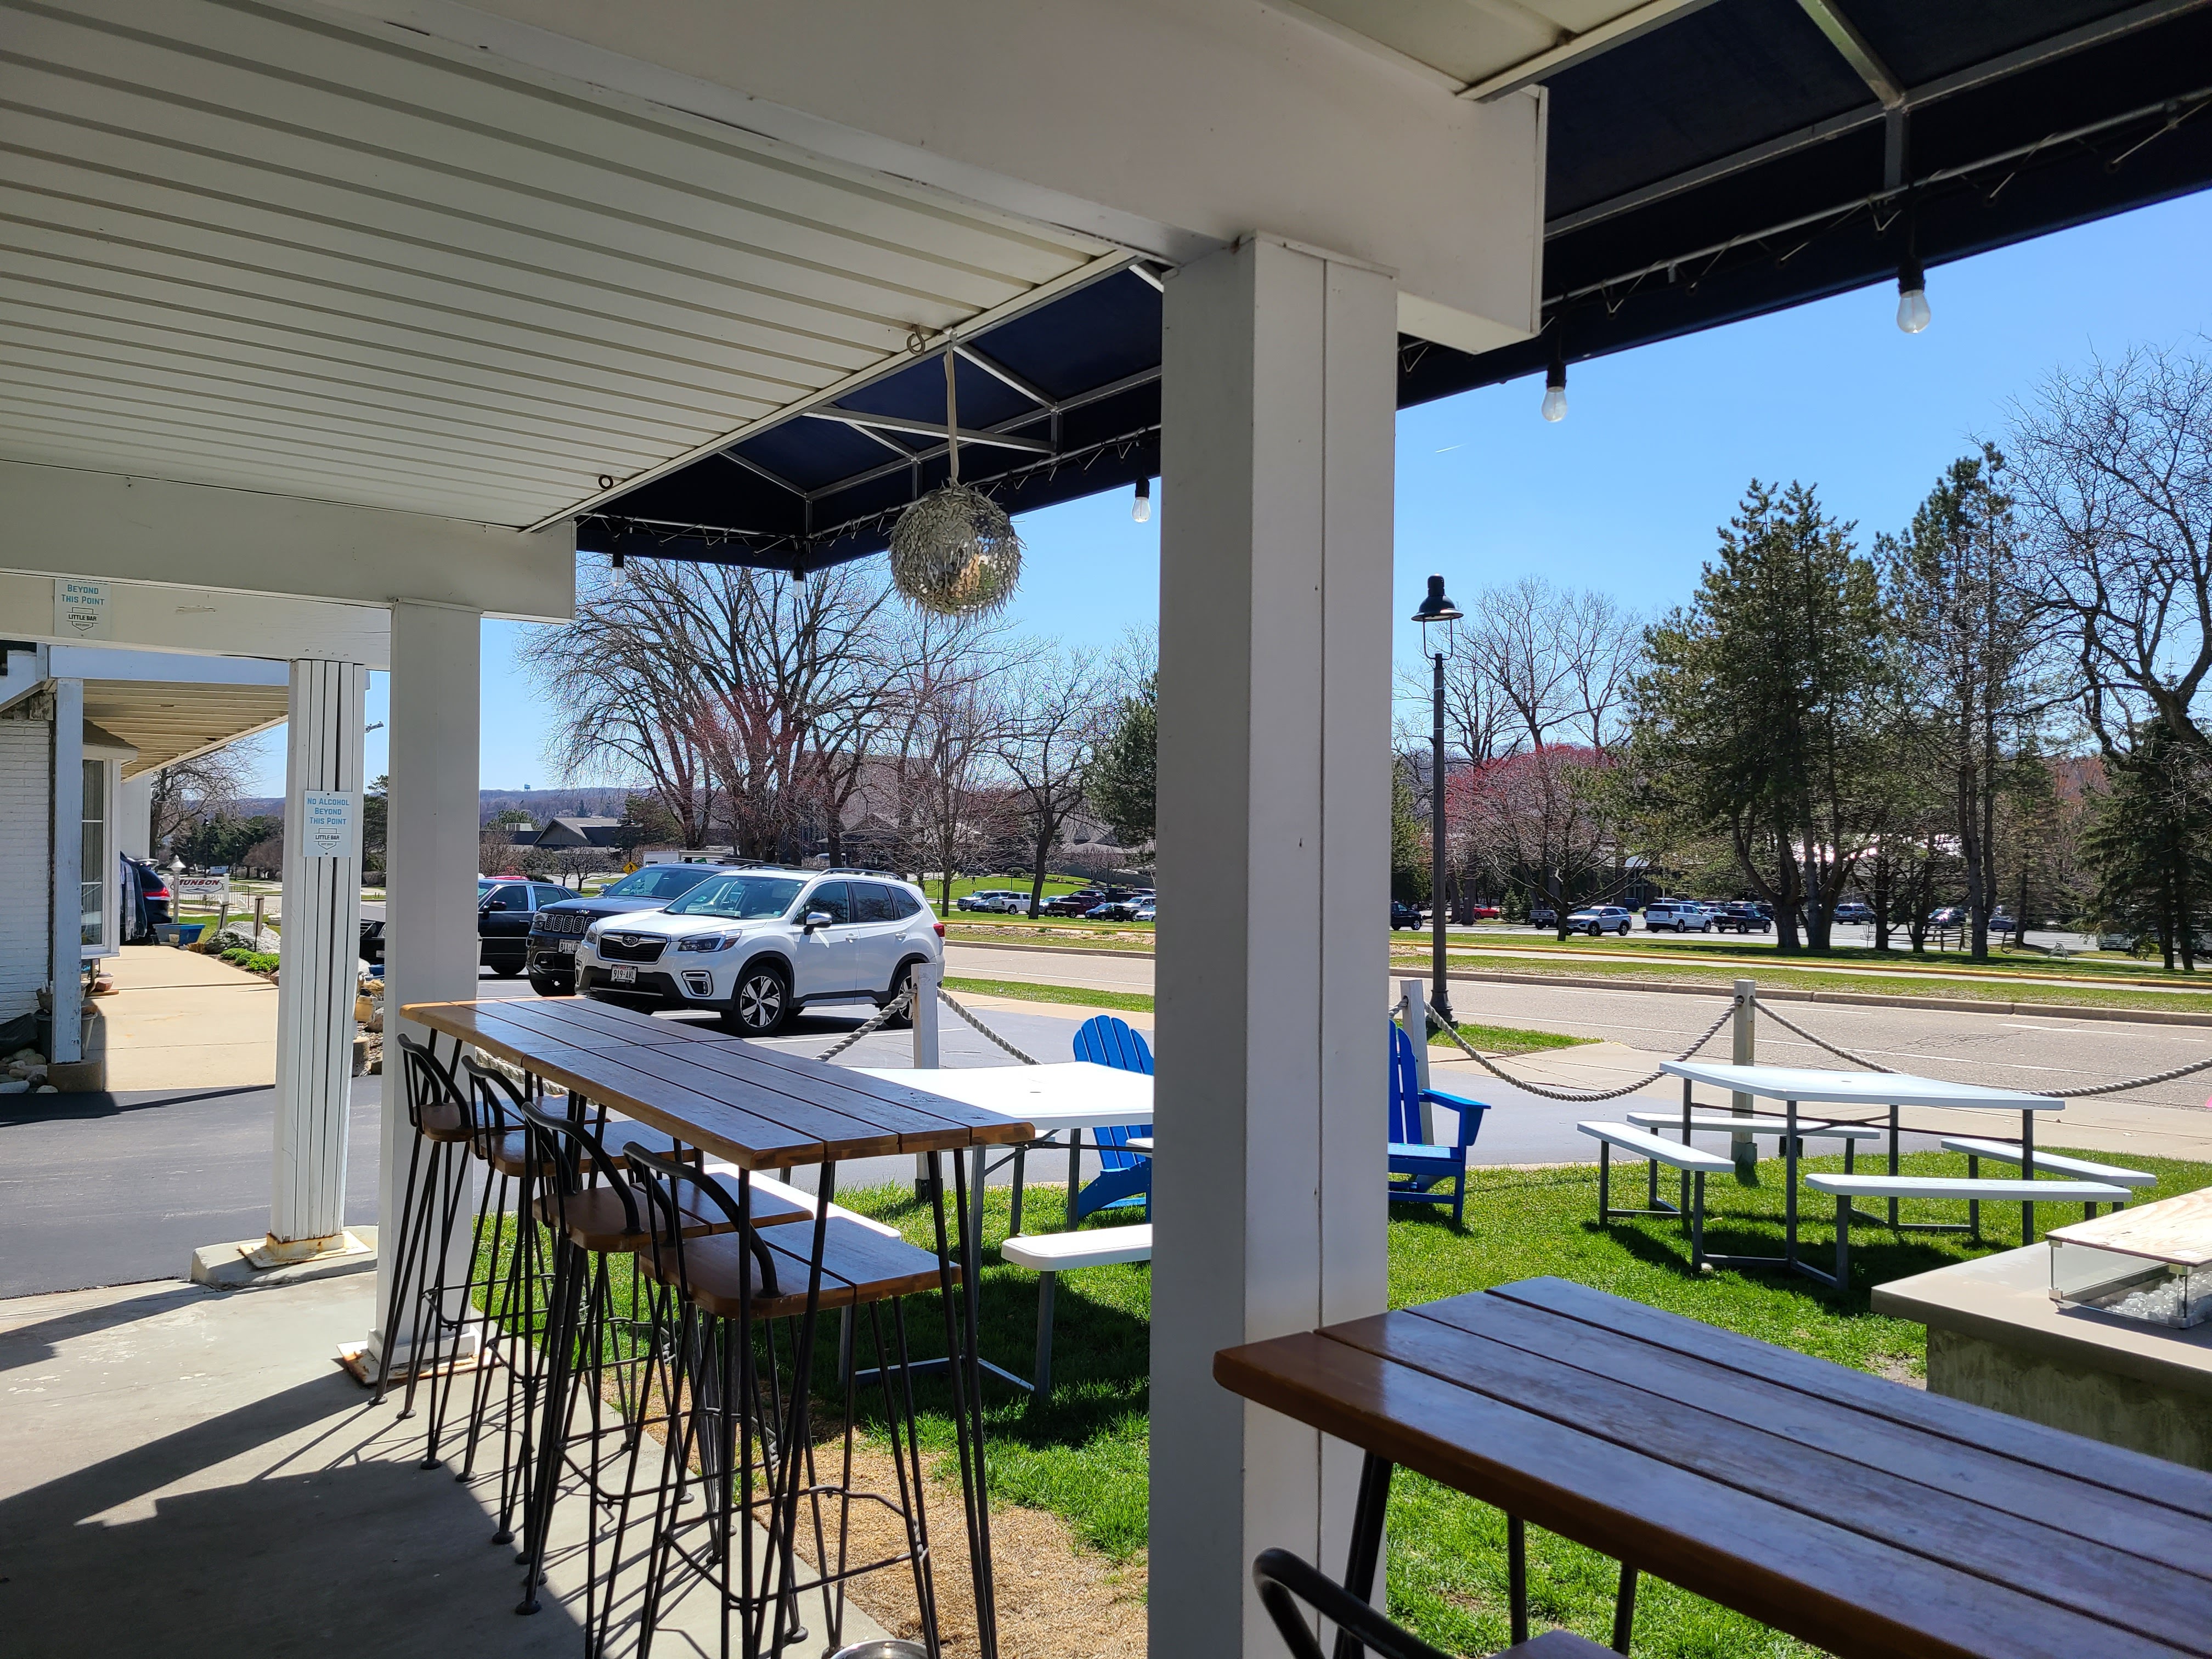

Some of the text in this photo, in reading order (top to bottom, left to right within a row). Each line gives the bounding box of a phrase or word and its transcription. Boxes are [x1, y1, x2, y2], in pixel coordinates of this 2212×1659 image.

[67, 584, 99, 594] BEYOND
[61, 594, 105, 605] THIS POINT
[319, 798, 349, 806] ALCOHOL
